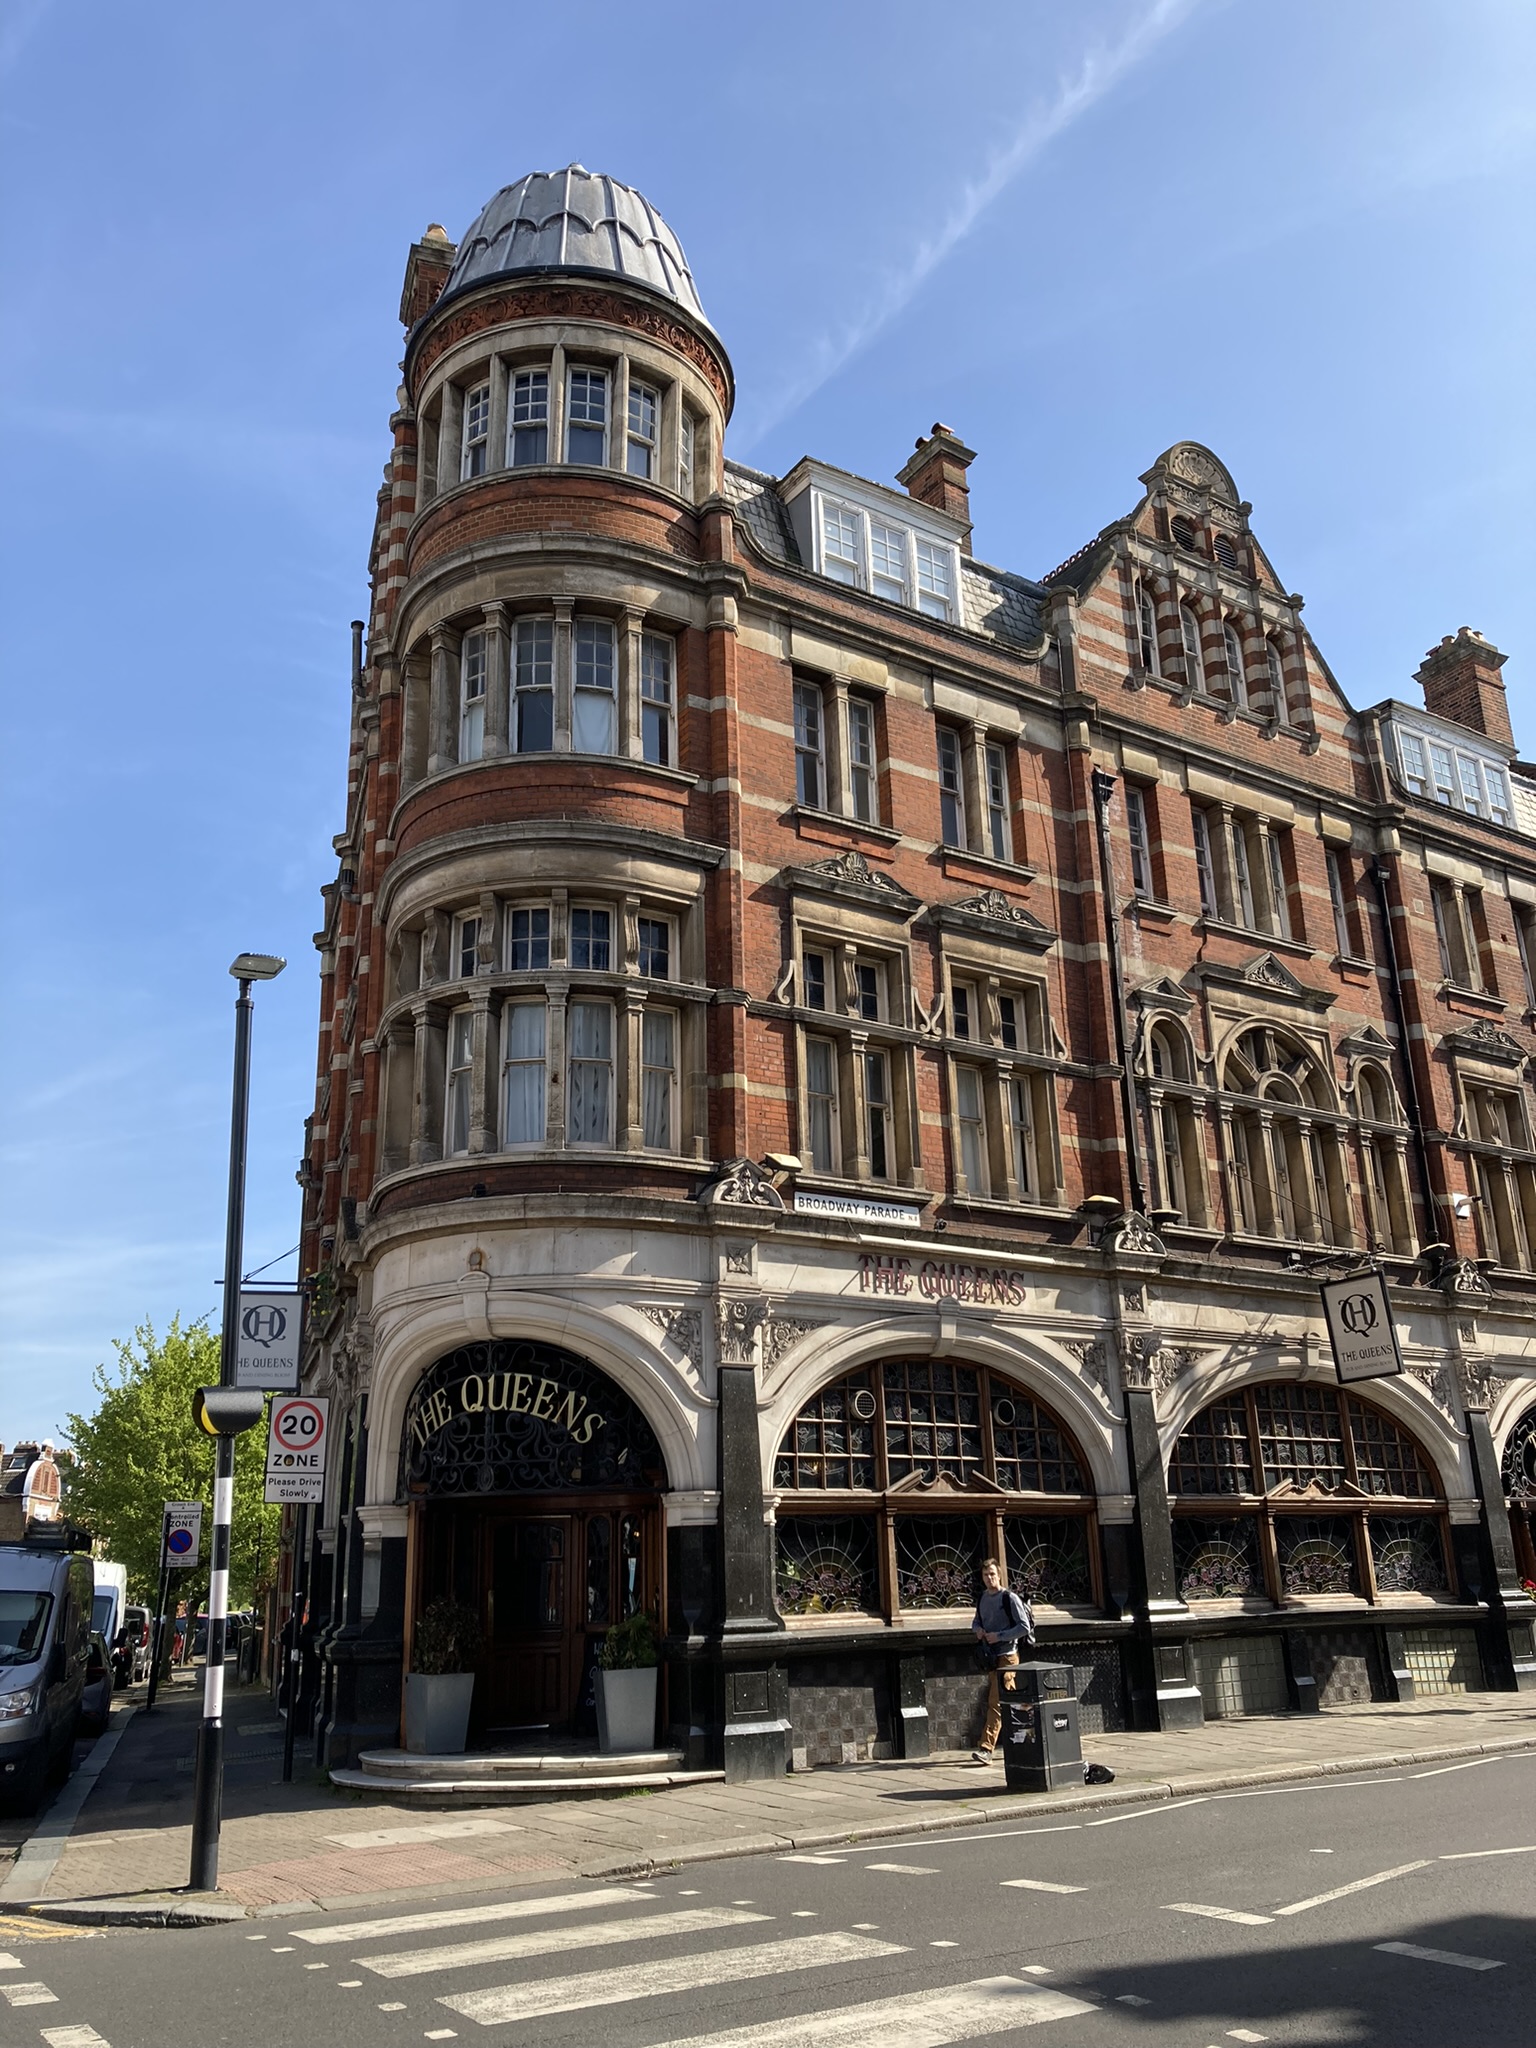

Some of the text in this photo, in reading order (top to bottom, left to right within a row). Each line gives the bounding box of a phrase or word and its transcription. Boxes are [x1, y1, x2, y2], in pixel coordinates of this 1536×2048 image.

[798, 1196, 860, 1214] BROADWAY
[864, 1205, 905, 1219] PARADE
[858, 1254, 1027, 1304] THE QUEENS
[1341, 1345, 1393, 1362] THE QUEENS
[238, 1358, 294, 1368] HE QUEENS
[411, 1372, 607, 1448] THE QUEENS
[282, 1415, 317, 1435] 20
[273, 1454, 319, 1467] ZONE
[268, 1478, 321, 1486] Please Drive
[280, 1489, 309, 1498] Slowly
